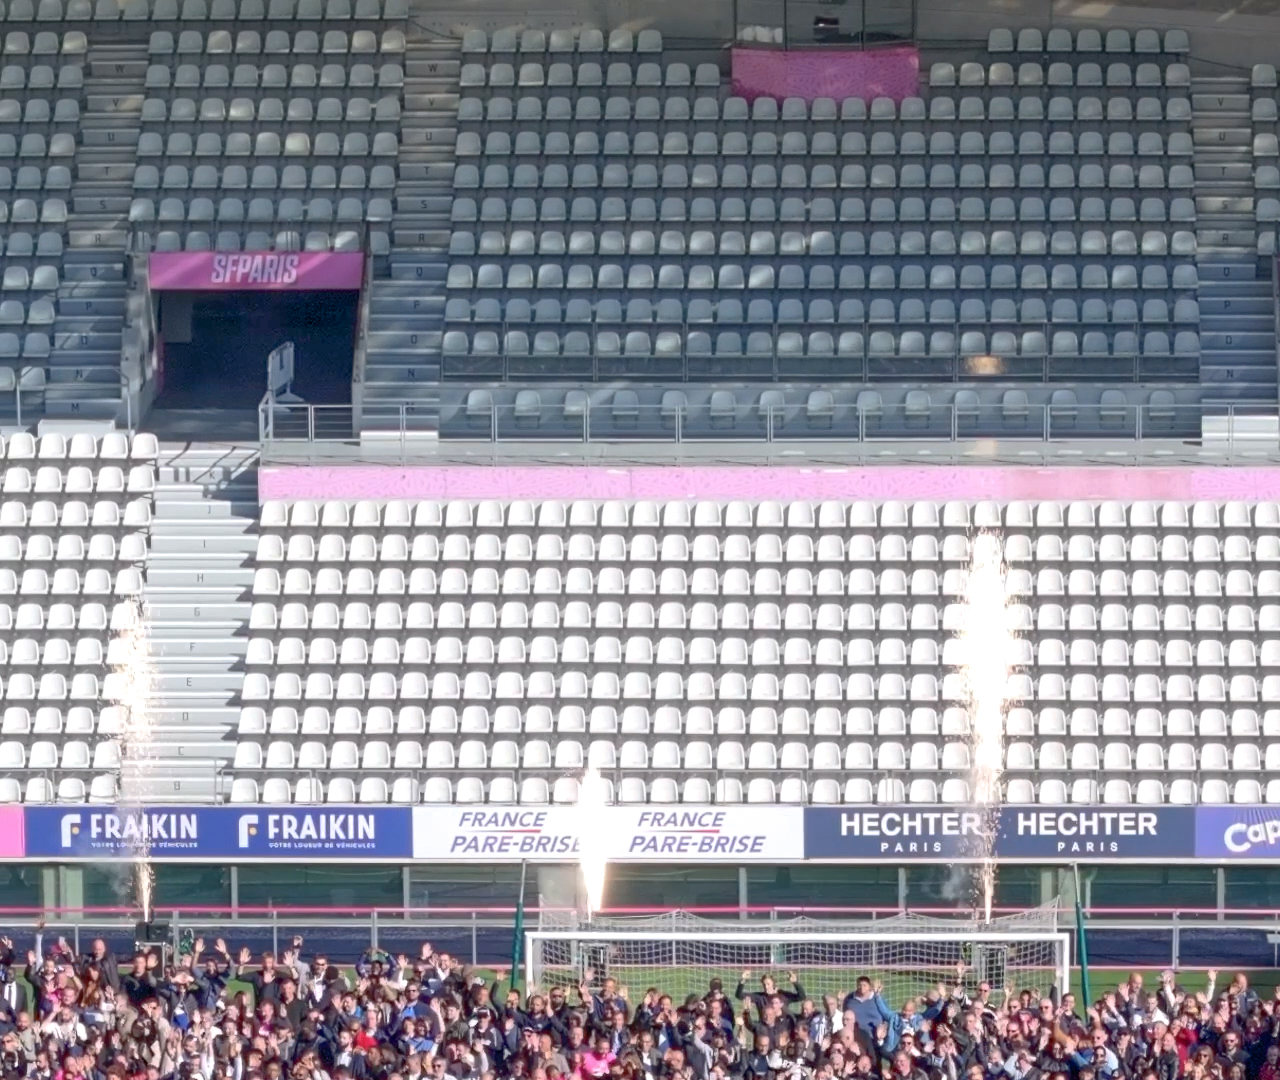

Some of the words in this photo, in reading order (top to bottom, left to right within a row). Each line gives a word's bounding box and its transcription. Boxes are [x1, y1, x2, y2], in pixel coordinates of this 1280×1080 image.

[211, 255, 300, 284] SFPARIS
[91, 813, 198, 839] FRAIKIN
[268, 814, 376, 839] FRAIKIN
[459, 811, 548, 827] FRANCE
[637, 811, 727, 828] FRANCE
[840, 812, 981, 836] HECHTER
[1017, 812, 1157, 836] HECHTER
[628, 835, 766, 853] PARE-BRISE
[880, 842, 942, 852] PARIS
[1057, 842, 1119, 852] PARIS
